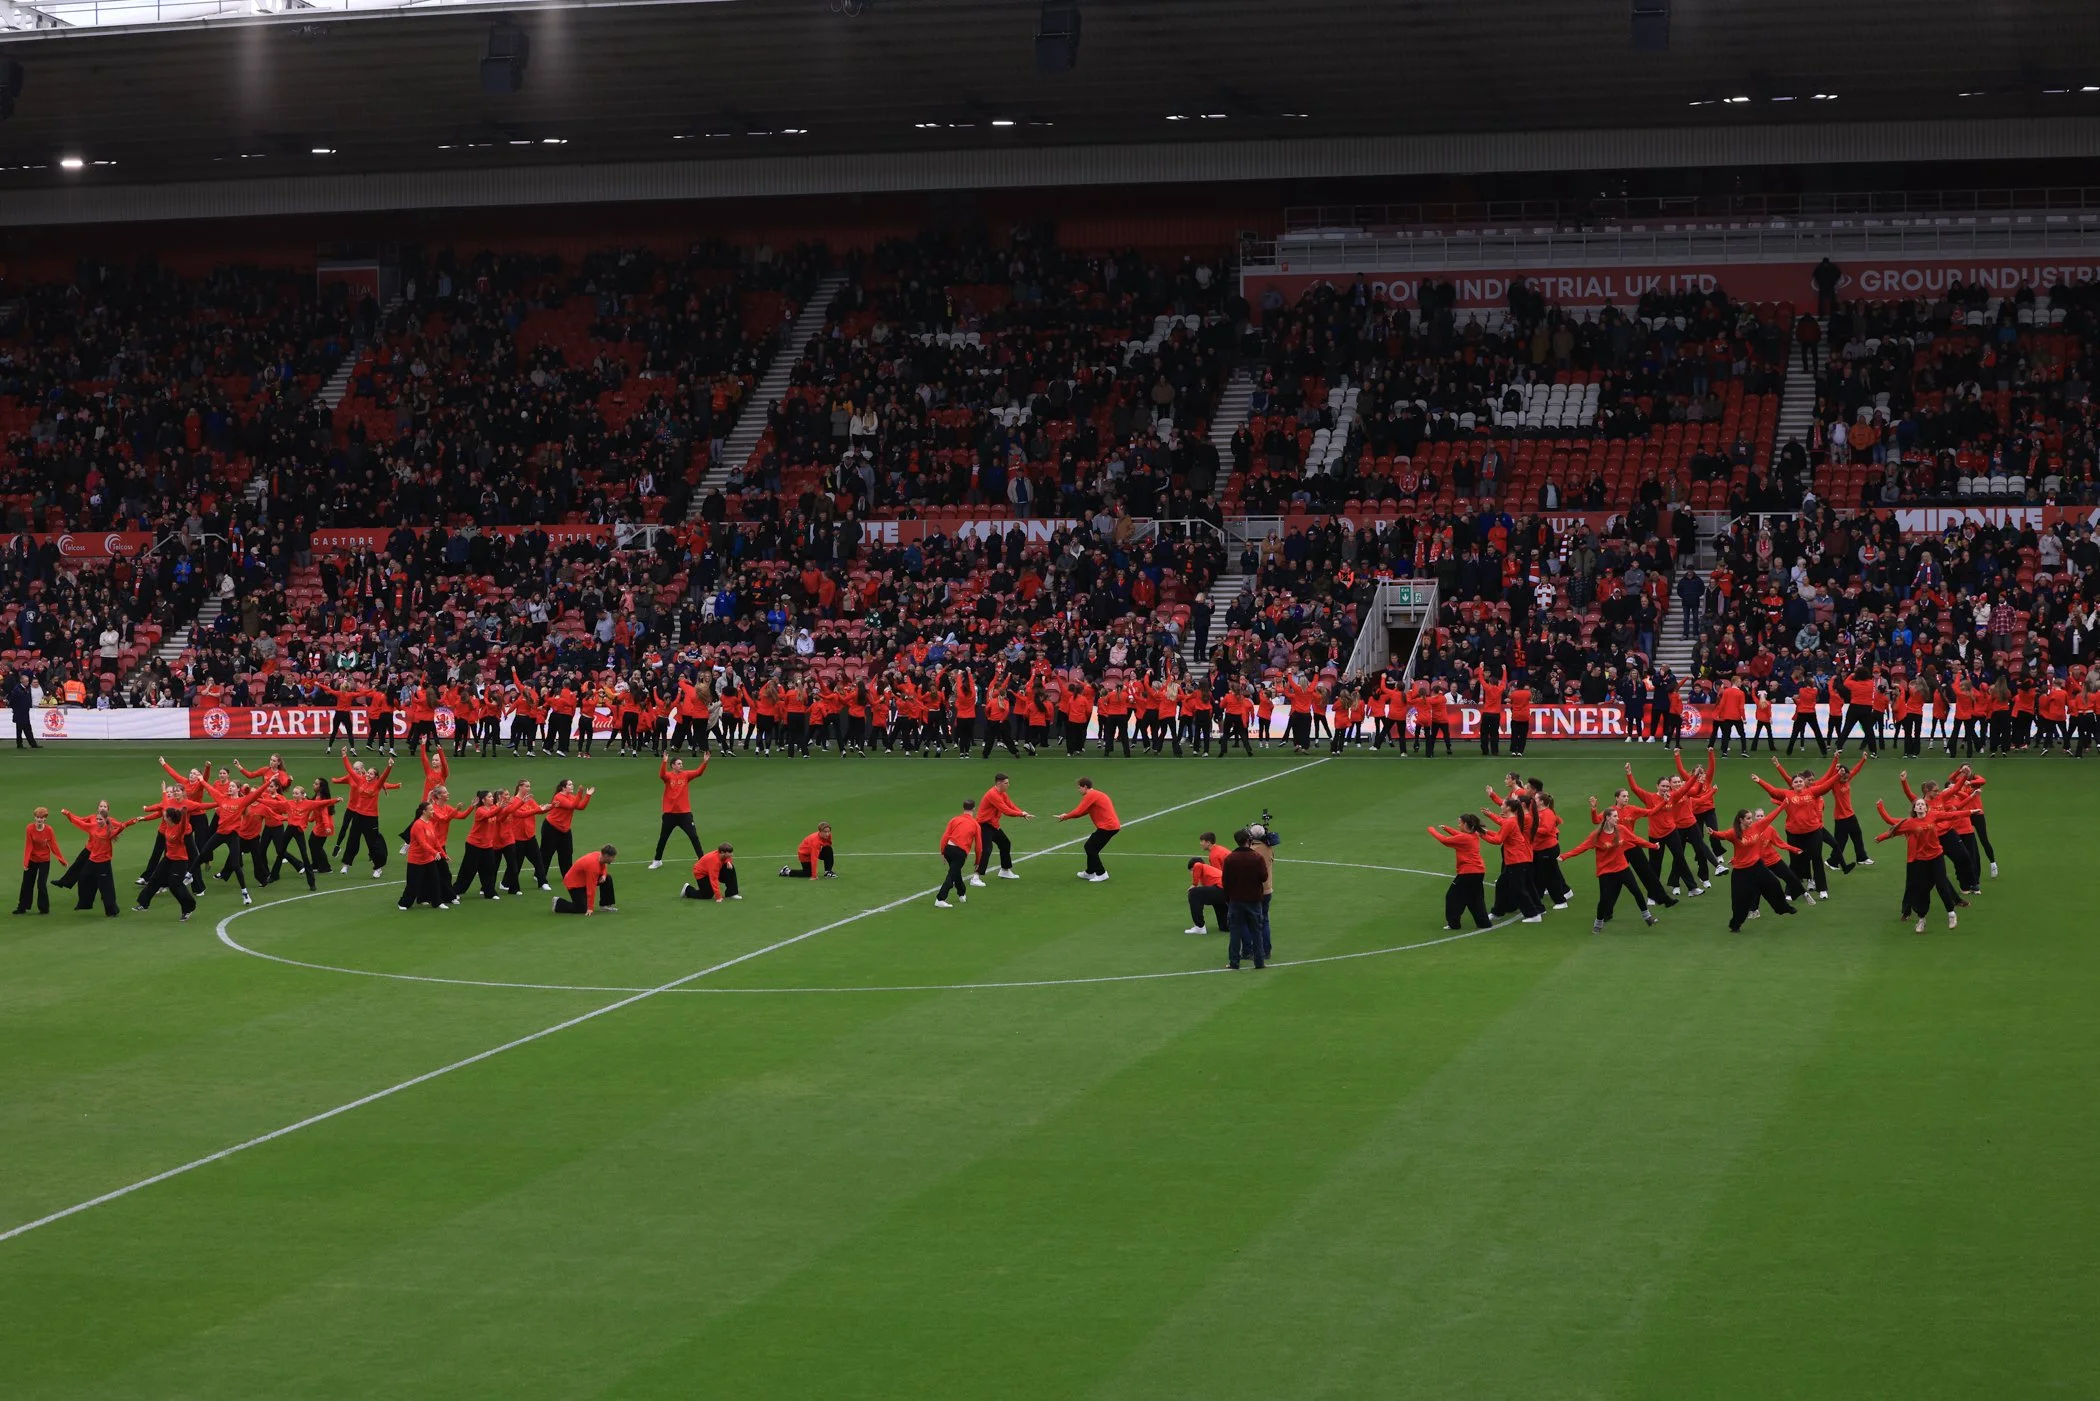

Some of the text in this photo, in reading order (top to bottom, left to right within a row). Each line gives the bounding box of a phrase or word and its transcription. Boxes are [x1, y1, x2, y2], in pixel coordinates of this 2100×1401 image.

[1455, 275, 1617, 301] INDSTRIAL
[1625, 275, 1662, 297] UK
[1860, 268, 1963, 291] GROUP
[313, 537, 374, 546] CASTORE
[251, 709, 407, 735] PARTES
[1461, 707, 1644, 735] PTNER
